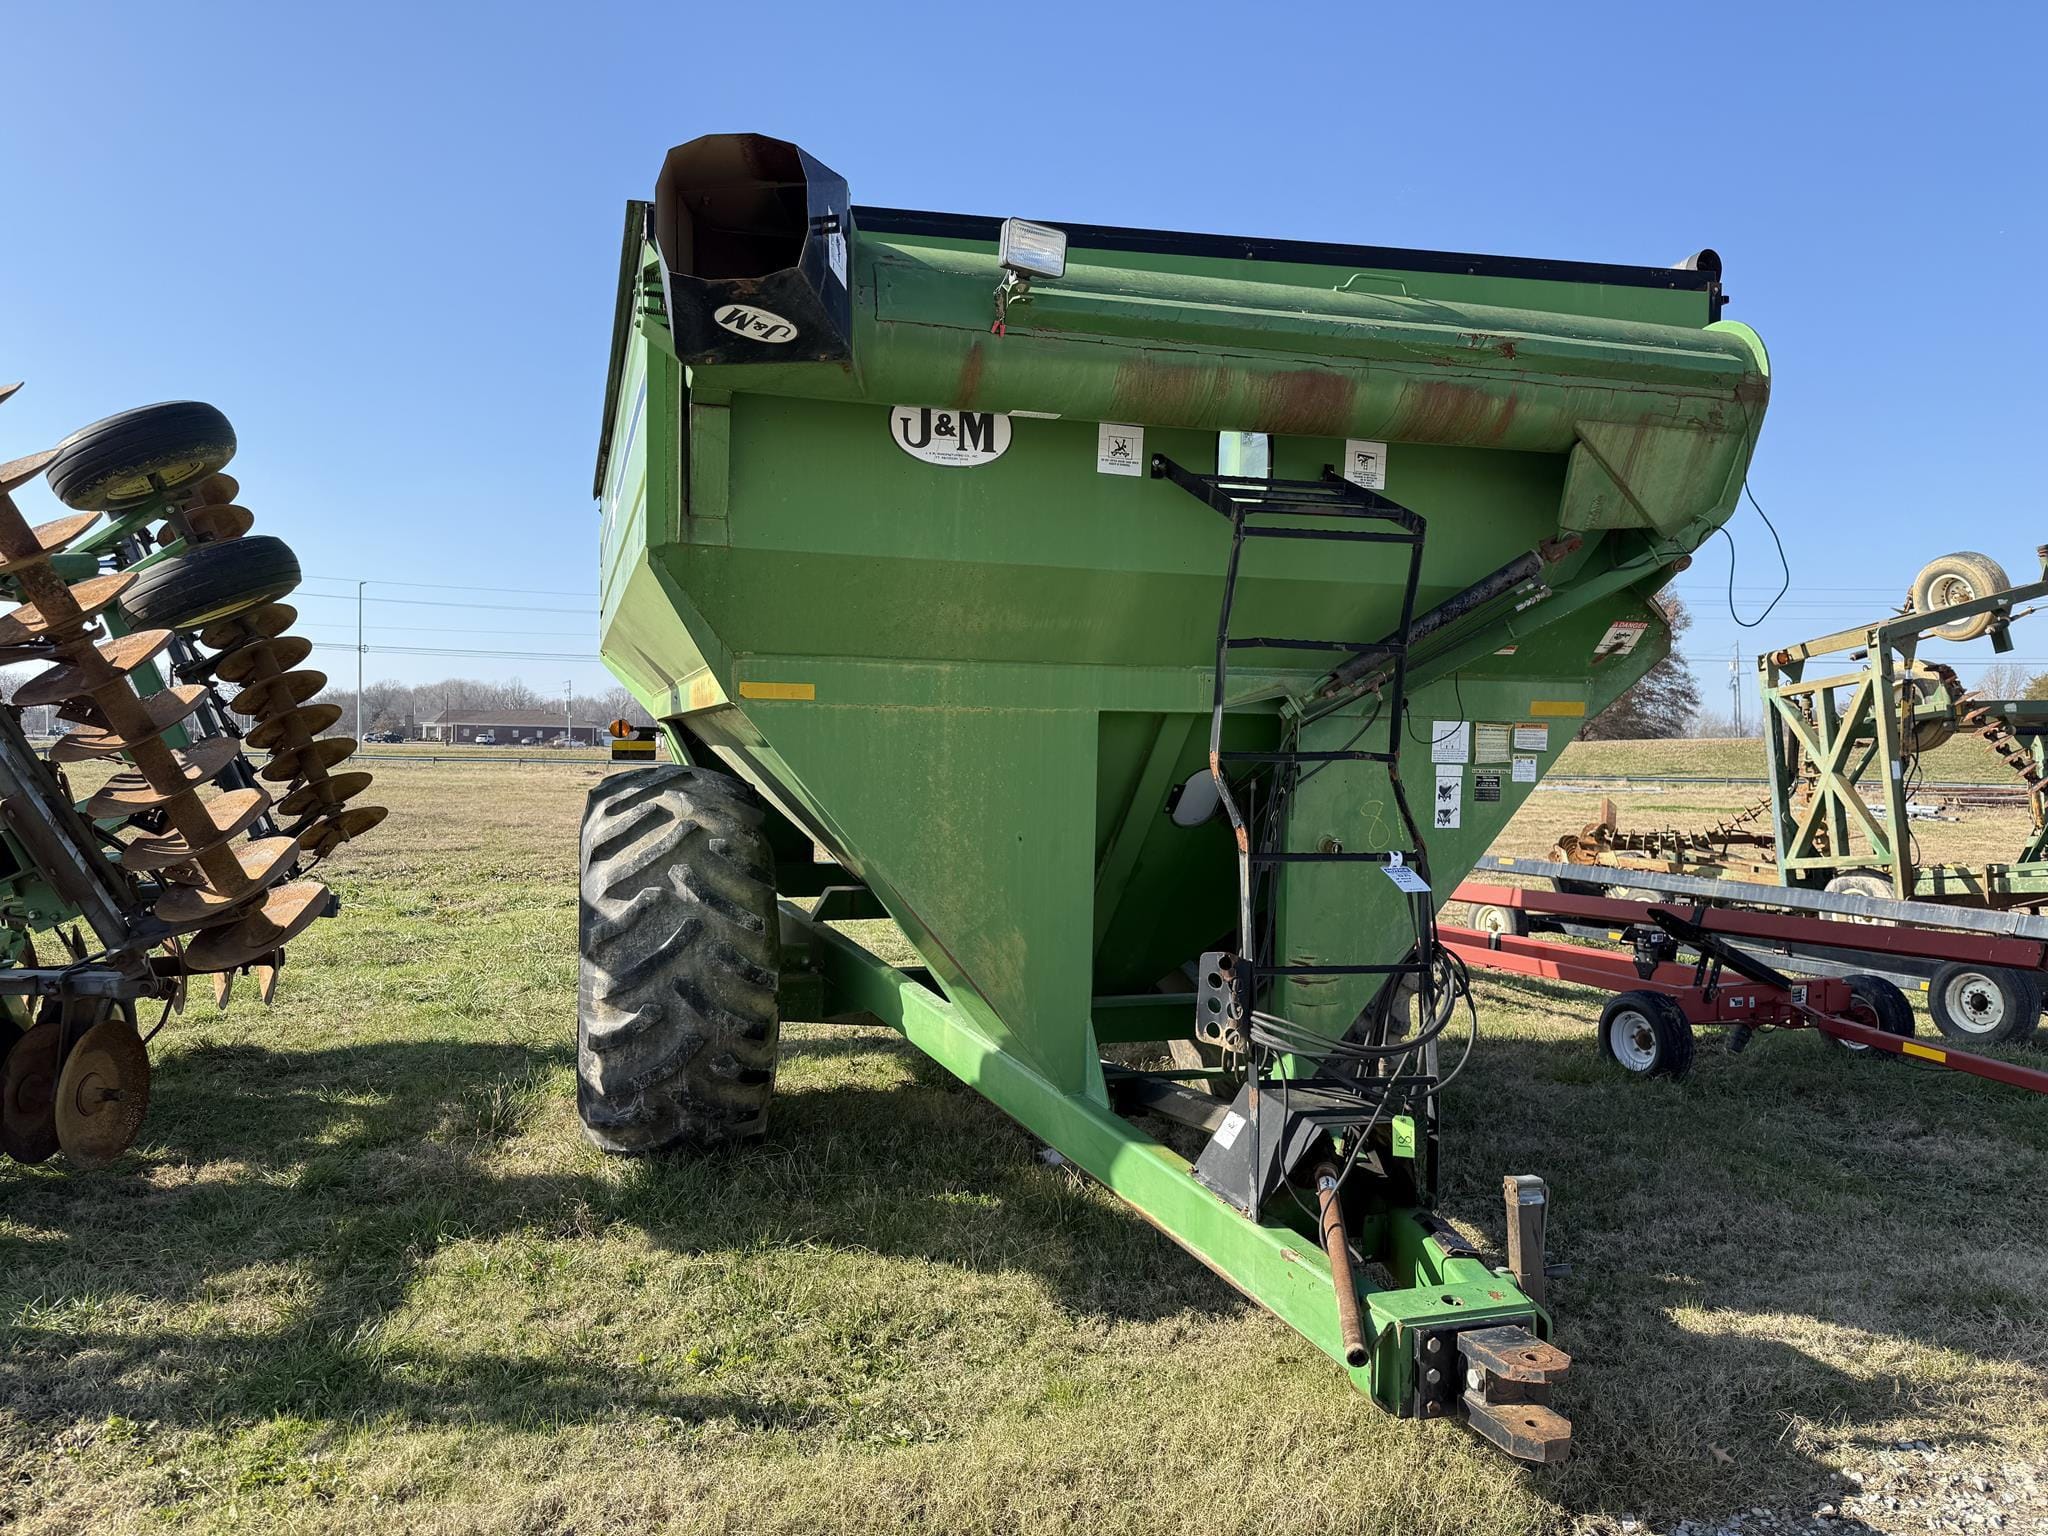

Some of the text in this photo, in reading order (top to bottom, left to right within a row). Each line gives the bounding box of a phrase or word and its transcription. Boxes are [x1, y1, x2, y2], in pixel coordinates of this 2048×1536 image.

[719, 306, 792, 340] J&M
[899, 407, 997, 453] J&M
[1619, 621, 1648, 630] DANGER
